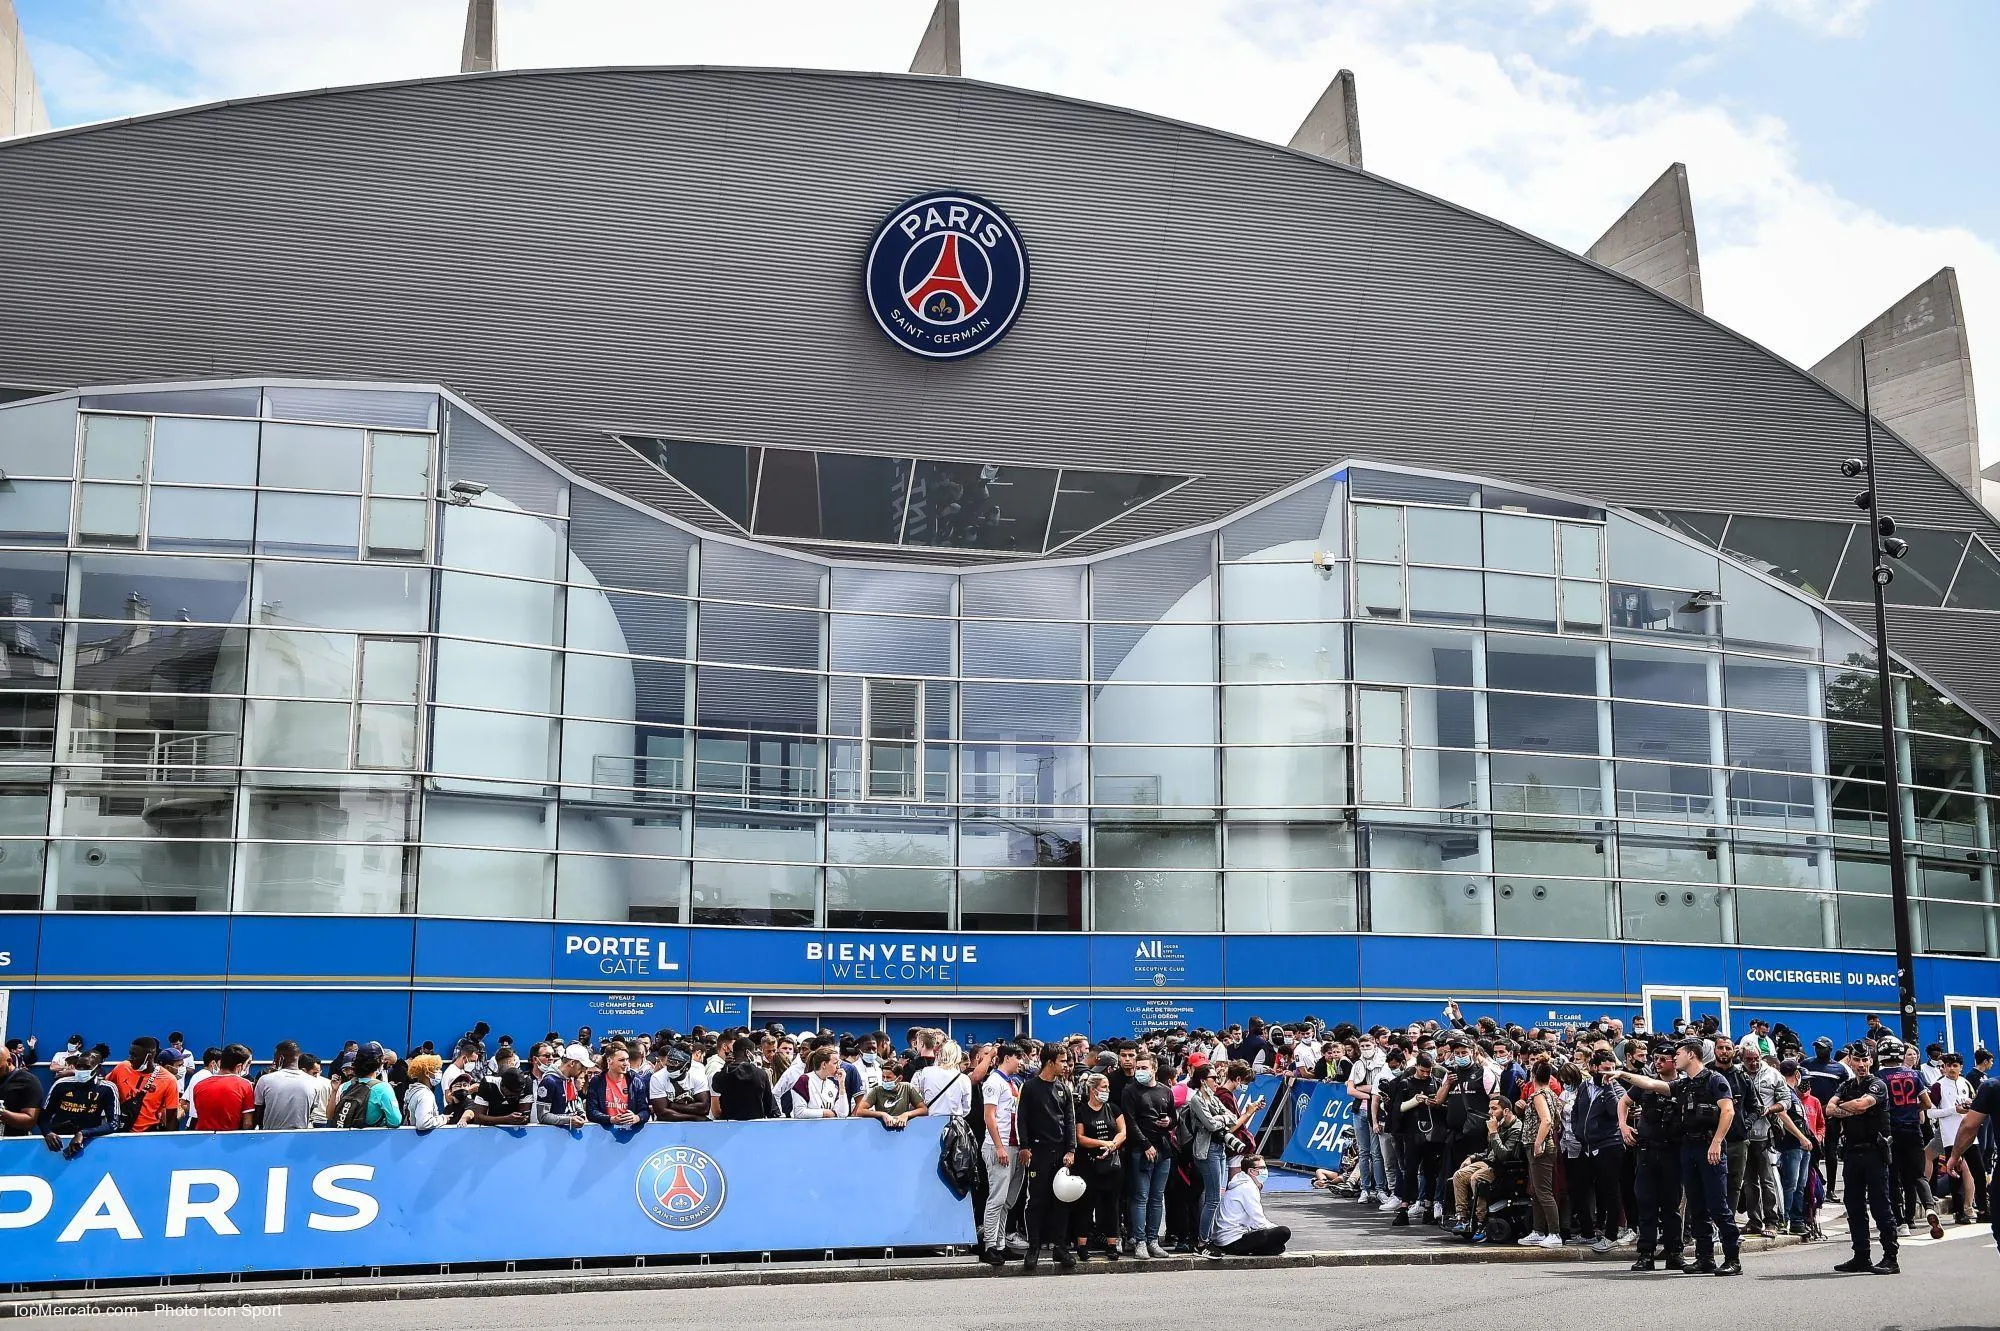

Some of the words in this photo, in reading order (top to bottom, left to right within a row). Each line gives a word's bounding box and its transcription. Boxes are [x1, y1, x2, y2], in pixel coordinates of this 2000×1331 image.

[900, 206, 1002, 248] PARIS
[890, 309, 924, 339] SAINT
[934, 318, 991, 344] GERMAIN
[566, 936, 650, 956] PORTE
[658, 942, 679, 970] L
[807, 943, 977, 962] BIENVENUE
[600, 958, 650, 975] GATE
[832, 963, 951, 980] WELCOME
[1747, 969, 1842, 985] CONCIERGERIE
[1848, 974, 1863, 985] DU
[1867, 975, 1897, 987] PARC
[1890, 1079, 1917, 1106] 92
[1322, 1100, 1343, 1119] ICI
[1307, 1121, 1354, 1153] PAR
[651, 1150, 709, 1171] PARIS
[0, 1163, 380, 1242] PARIS
[652, 1206, 674, 1220] SAINT
[679, 1205, 711, 1222] GERMAIN
